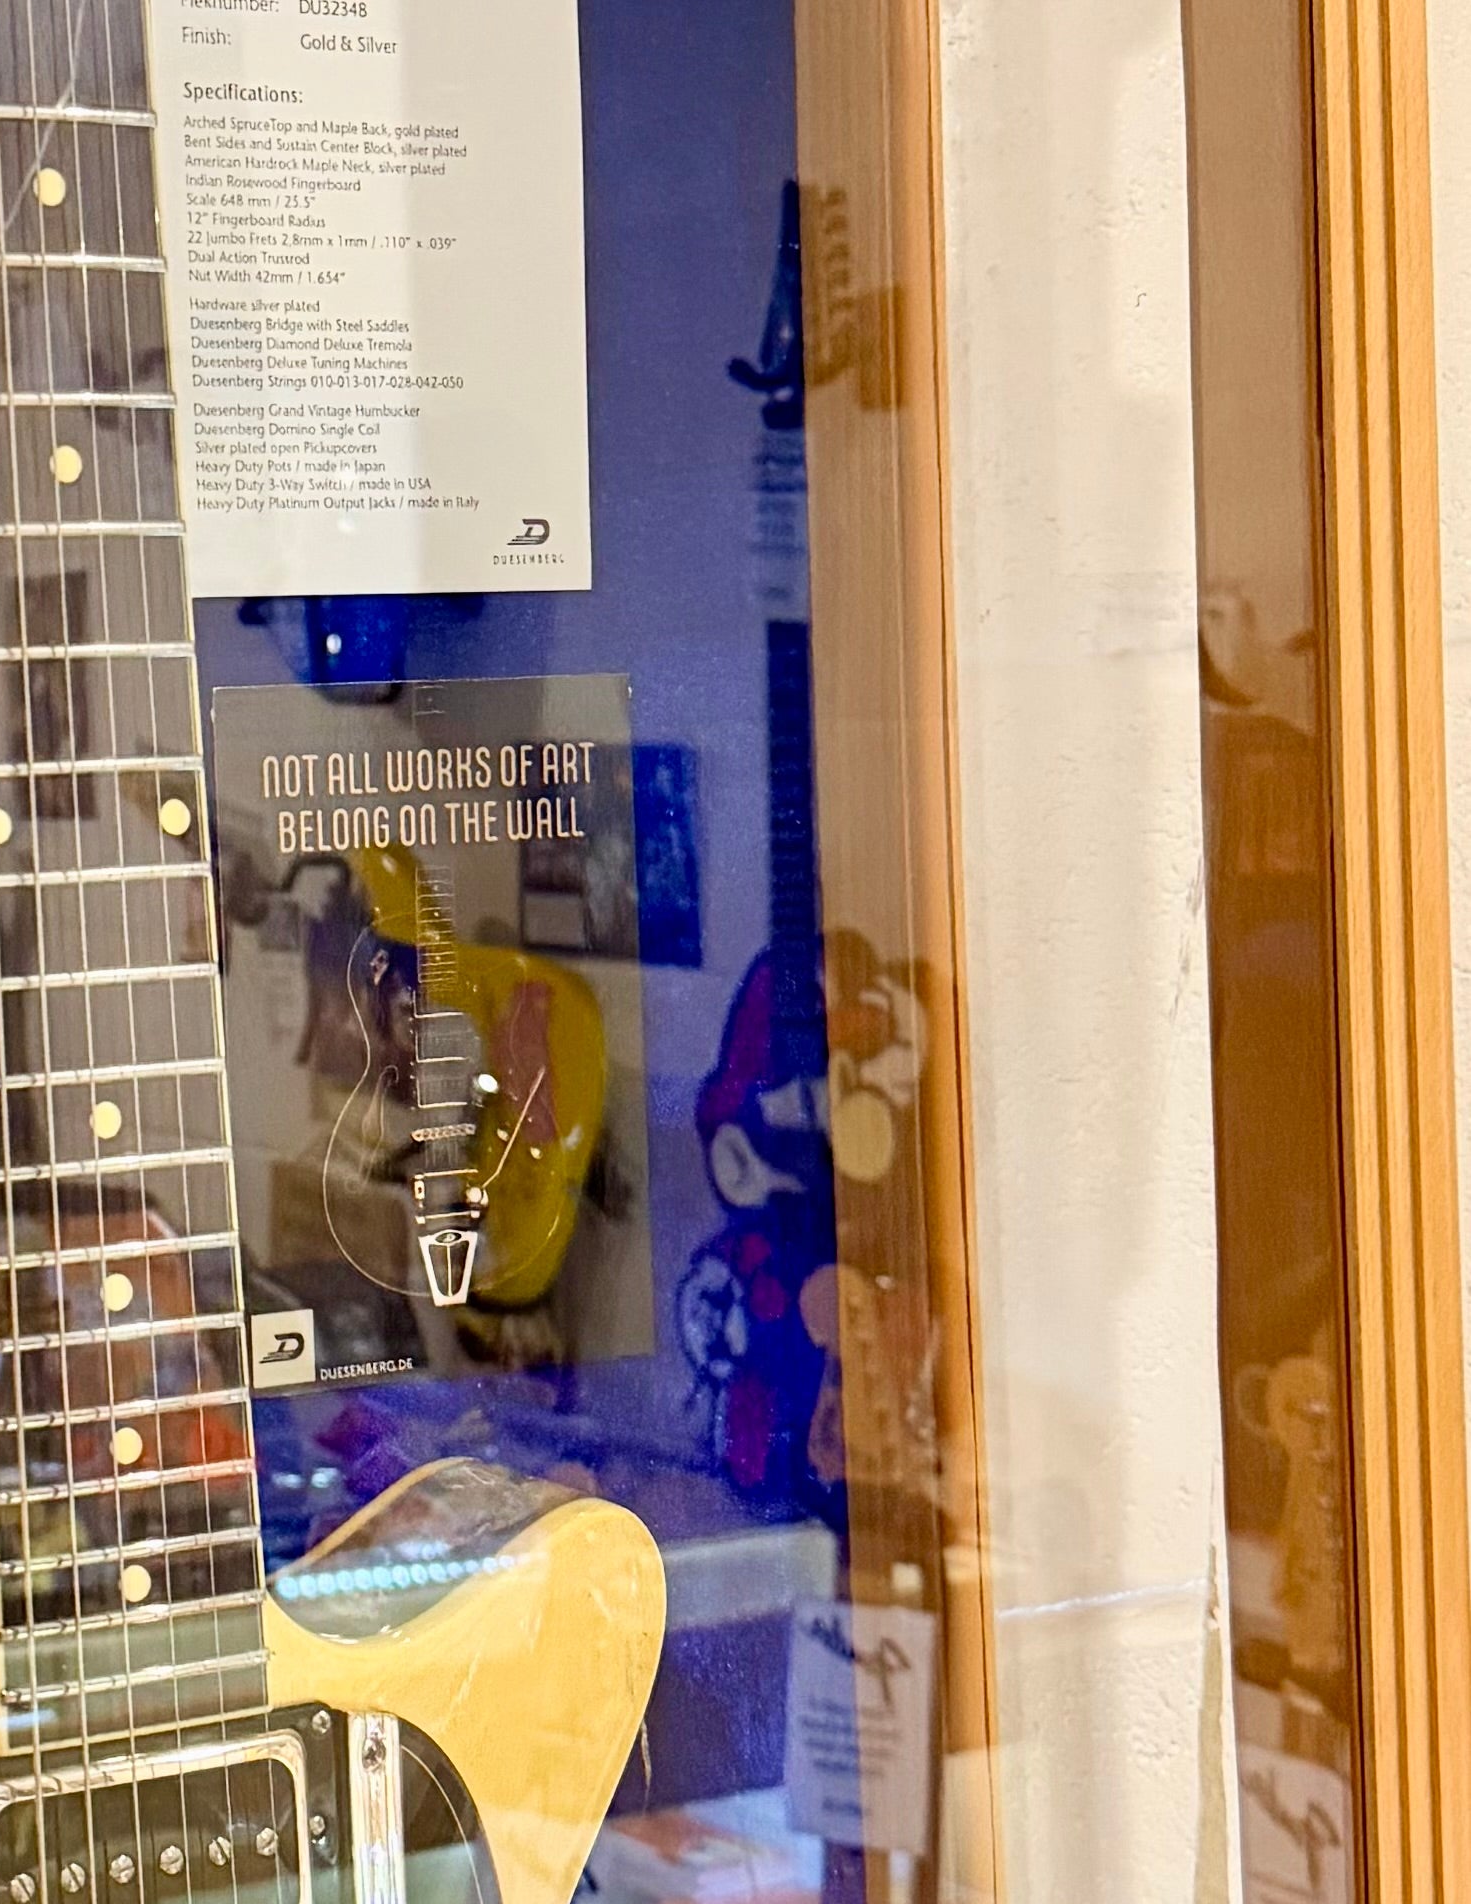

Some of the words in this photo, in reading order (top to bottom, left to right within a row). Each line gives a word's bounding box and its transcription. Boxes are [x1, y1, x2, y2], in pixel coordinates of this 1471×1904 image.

[182, 26, 231, 46] Finish:
[300, 33, 336, 52] Gold
[340, 35, 353, 52] &
[356, 35, 398, 54] Silver
[183, 82, 303, 104] Specifications:
[183, 114, 226, 130] Arched
[296, 119, 318, 134] and
[322, 120, 358, 138] Maple
[362, 121, 391, 139] Back,
[394, 123, 420, 141] gold
[424, 125, 458, 142] plated
[184, 134, 211, 148] Bent
[216, 135, 246, 150] Sides
[249, 136, 272, 151] and
[276, 138, 317, 152] Sustain
[320, 139, 359, 154] Center
[363, 141, 397, 158] Block,
[401, 142, 429, 157] silver
[432, 143, 467, 161] plated
[185, 154, 241, 169] American
[245, 156, 299, 171] Hardrock
[302, 157, 339, 174] Maple
[342, 158, 374, 175] Neck,
[379, 160, 407, 175] silver
[410, 161, 445, 179] plated
[186, 173, 223, 188] Indian
[227, 173, 287, 190] Rosewood
[291, 176, 361, 195] Fingerboard
[186, 192, 217, 207] Scale
[220, 193, 244, 207] 648
[248, 197, 271, 208] mm
[212, 212, 284, 230] Fingerboard
[288, 214, 326, 228] Radius
[187, 230, 203, 244] 22
[206, 231, 246, 247] Jumbo
[250, 231, 277, 246] Frets
[338, 234, 368, 249] 1mm
[188, 249, 215, 264] Dual
[219, 250, 257, 265] Action
[189, 269, 211, 283] Nut
[214, 268, 251, 283] Width
[255, 269, 293, 285] 42mm
[189, 295, 247, 312] Hardware
[251, 298, 280, 312] silver
[284, 298, 320, 315] plated
[190, 316, 262, 335] Duesenberg
[266, 316, 303, 336] Bridge
[306, 318, 332, 332] with
[336, 318, 363, 332] Steel
[367, 319, 409, 333] Saddles
[191, 335, 263, 353] Duesenberg
[266, 336, 320, 353] Diamond
[324, 337, 363, 352] Deluxe
[191, 353, 263, 372] Duesenberg
[267, 355, 307, 370] Deluxe
[310, 355, 350, 374] Tuning
[354, 356, 408, 370] Machines
[192, 373, 263, 391] Duesenberg
[268, 374, 307, 393] Strings
[193, 402, 264, 421] Duesenberg
[268, 403, 304, 418] Grand
[308, 403, 352, 421] Vintage
[355, 403, 420, 418] Humbucker
[194, 421, 265, 439] Duesenberg
[269, 422, 316, 436] Domino
[320, 422, 354, 439] Single
[358, 422, 380, 436] Coil
[195, 441, 225, 454] Silver
[230, 441, 266, 457] plated
[270, 444, 300, 457] open
[304, 441, 377, 459] Pickupcovers
[196, 459, 231, 477] Heavy
[235, 459, 263, 476] Duty
[268, 458, 292, 472] Pots
[304, 459, 337, 473] made
[354, 459, 385, 476] Japan
[196, 475, 232, 495] Heavy
[235, 477, 265, 495] Duty
[268, 477, 304, 495] 3-Way
[359, 477, 391, 491] made
[408, 477, 431, 491] USA
[197, 496, 234, 513] Heavy
[236, 495, 265, 513] Duty
[268, 495, 319, 510] Platinum
[323, 496, 365, 513] Output
[369, 496, 396, 511] Jacks
[407, 495, 439, 510] made
[456, 496, 479, 512] Italy
[262, 753, 319, 798] NOT
[327, 750, 379, 795] ALL
[386, 746, 491, 792] WORKS
[498, 744, 534, 787] OF
[542, 742, 595, 786] ART
[277, 805, 390, 854] BELONG
[400, 803, 436, 846] ON
[444, 800, 498, 844] THE
[506, 796, 584, 841] WALL
[320, 1357, 413, 1381] DUESENBERG.DE
